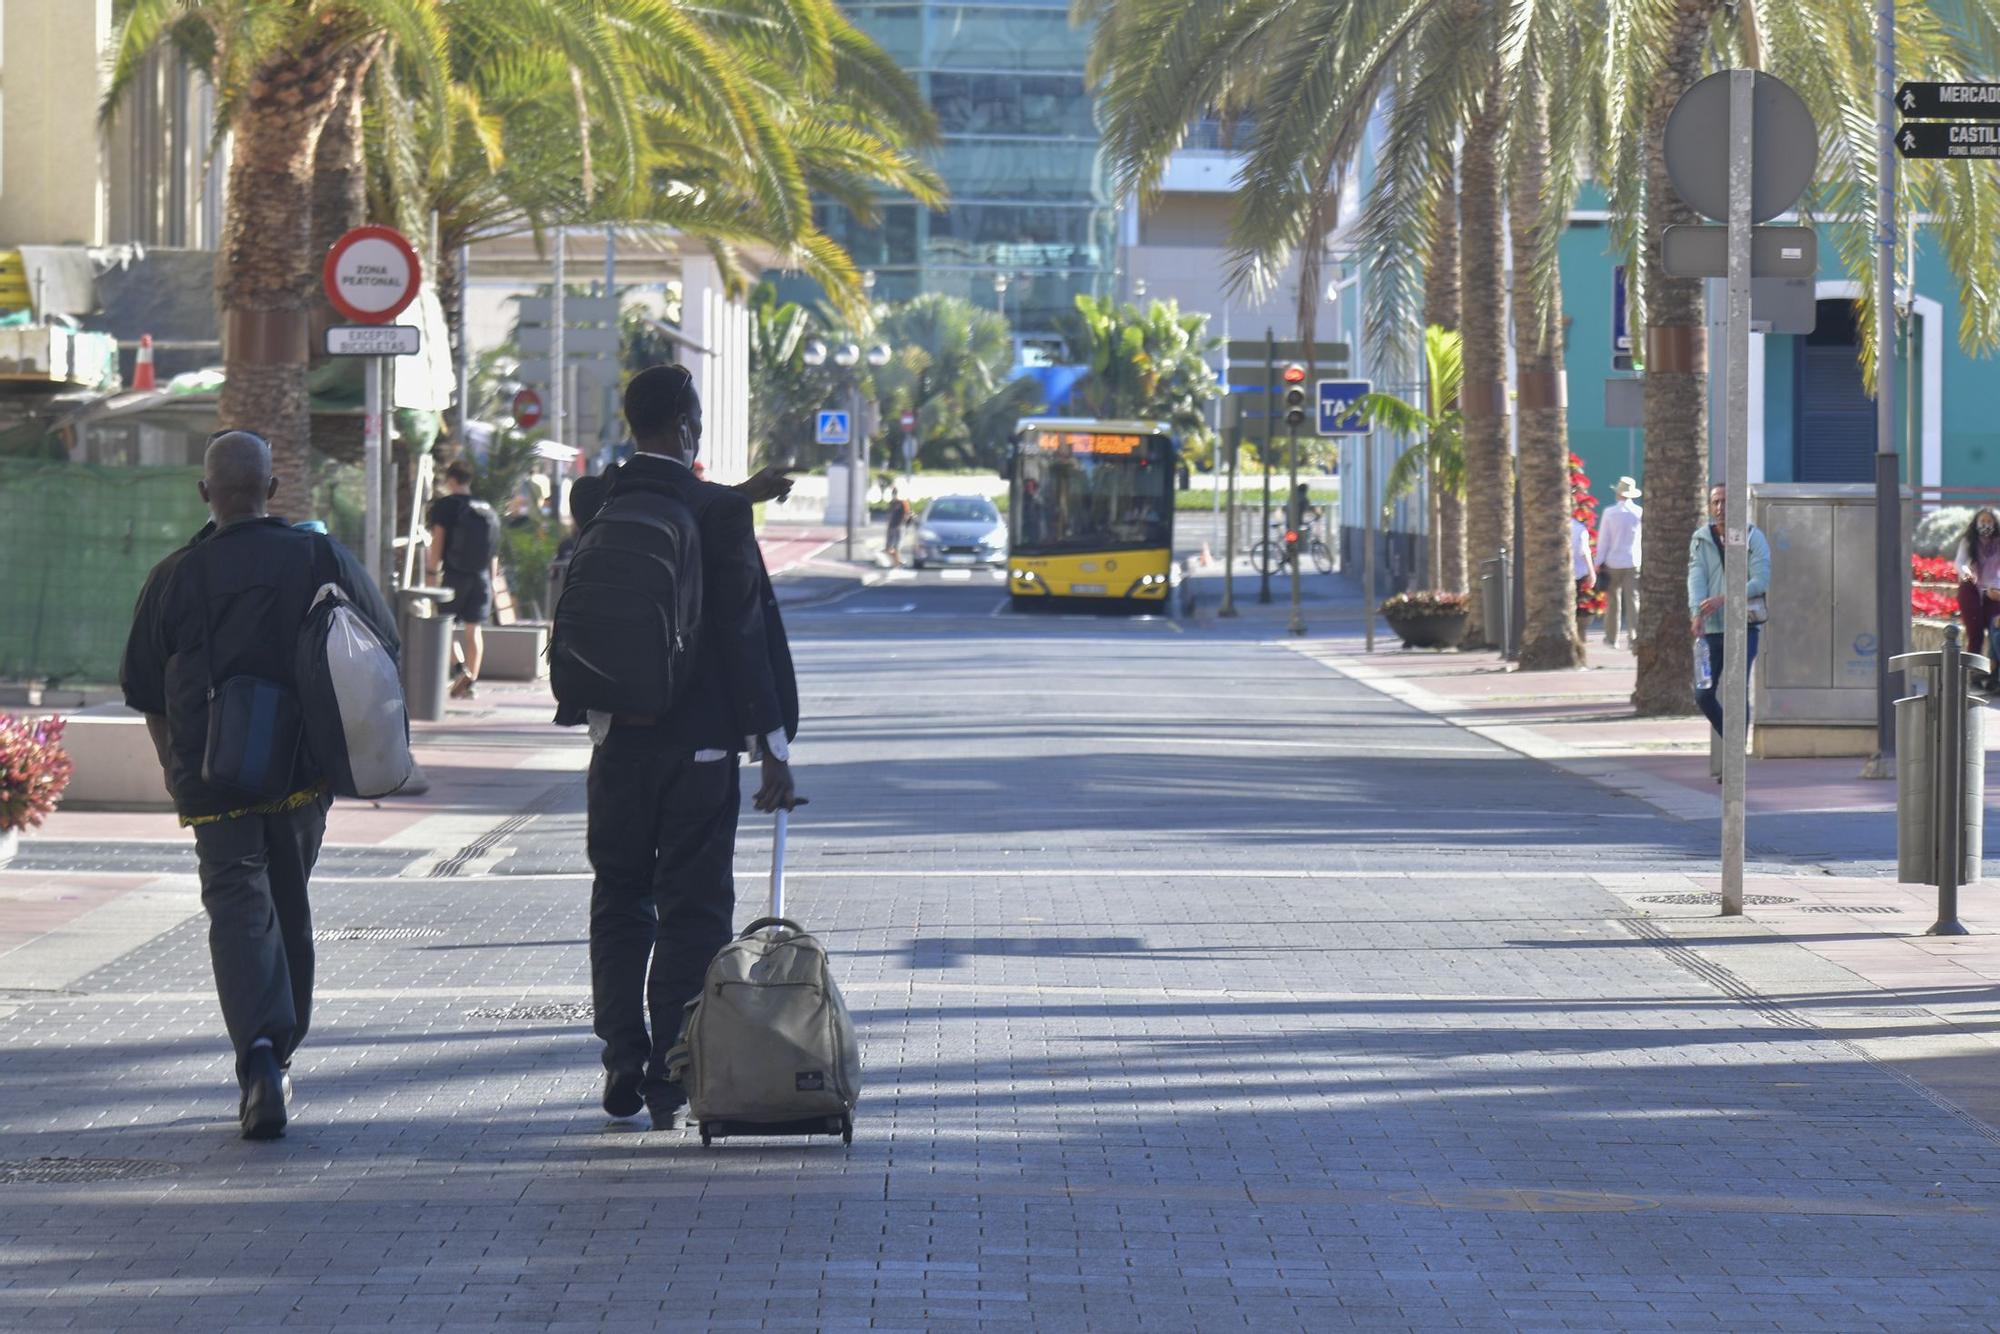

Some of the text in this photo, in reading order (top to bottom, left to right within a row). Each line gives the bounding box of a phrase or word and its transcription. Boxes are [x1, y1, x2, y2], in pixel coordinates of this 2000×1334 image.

[356, 266, 388, 274] ZONA
[342, 276, 400, 286] PEATONAL
[349, 331, 398, 340] EXCEPTO
[340, 342, 406, 352] BICICLETAS
